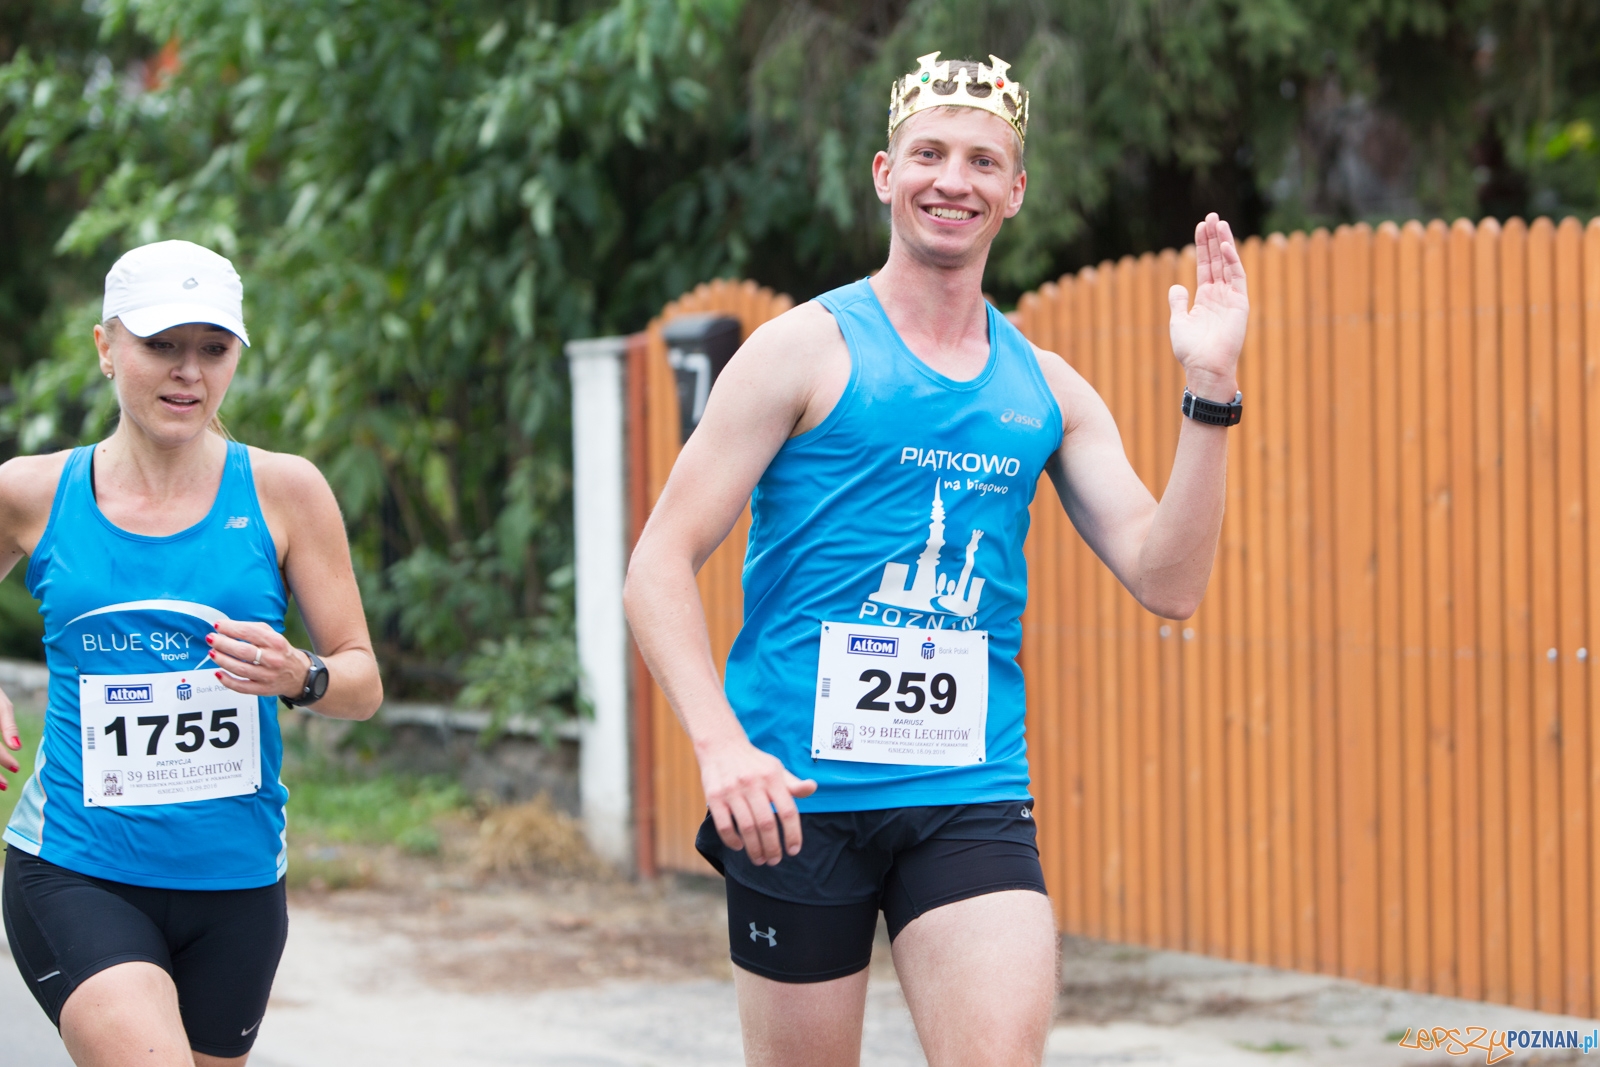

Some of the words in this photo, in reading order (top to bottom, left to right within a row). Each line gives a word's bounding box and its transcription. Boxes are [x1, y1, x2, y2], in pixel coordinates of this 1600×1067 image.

[1014, 413, 1042, 429] asics
[900, 447, 1021, 477] PIĄTKOWO
[943, 480, 961, 491] na
[966, 478, 1009, 496] biegowo
[82, 633, 144, 652] BLUE
[150, 632, 194, 650] SKY
[161, 652, 189, 661] travel
[954, 647, 969, 655] Polski
[196, 686, 213, 694] Bank
[856, 669, 957, 714] 259
[892, 718, 925, 726] MARIUSZ
[104, 708, 240, 756] 1755
[859, 725, 876, 738] 39
[880, 726, 911, 739] BIEG
[914, 727, 971, 741] LECHITÓW
[127, 770, 143, 782] 39
[147, 768, 178, 781] BIEG
[182, 759, 244, 778] LECHITÓW
[156, 759, 192, 767] PATRYCJA
